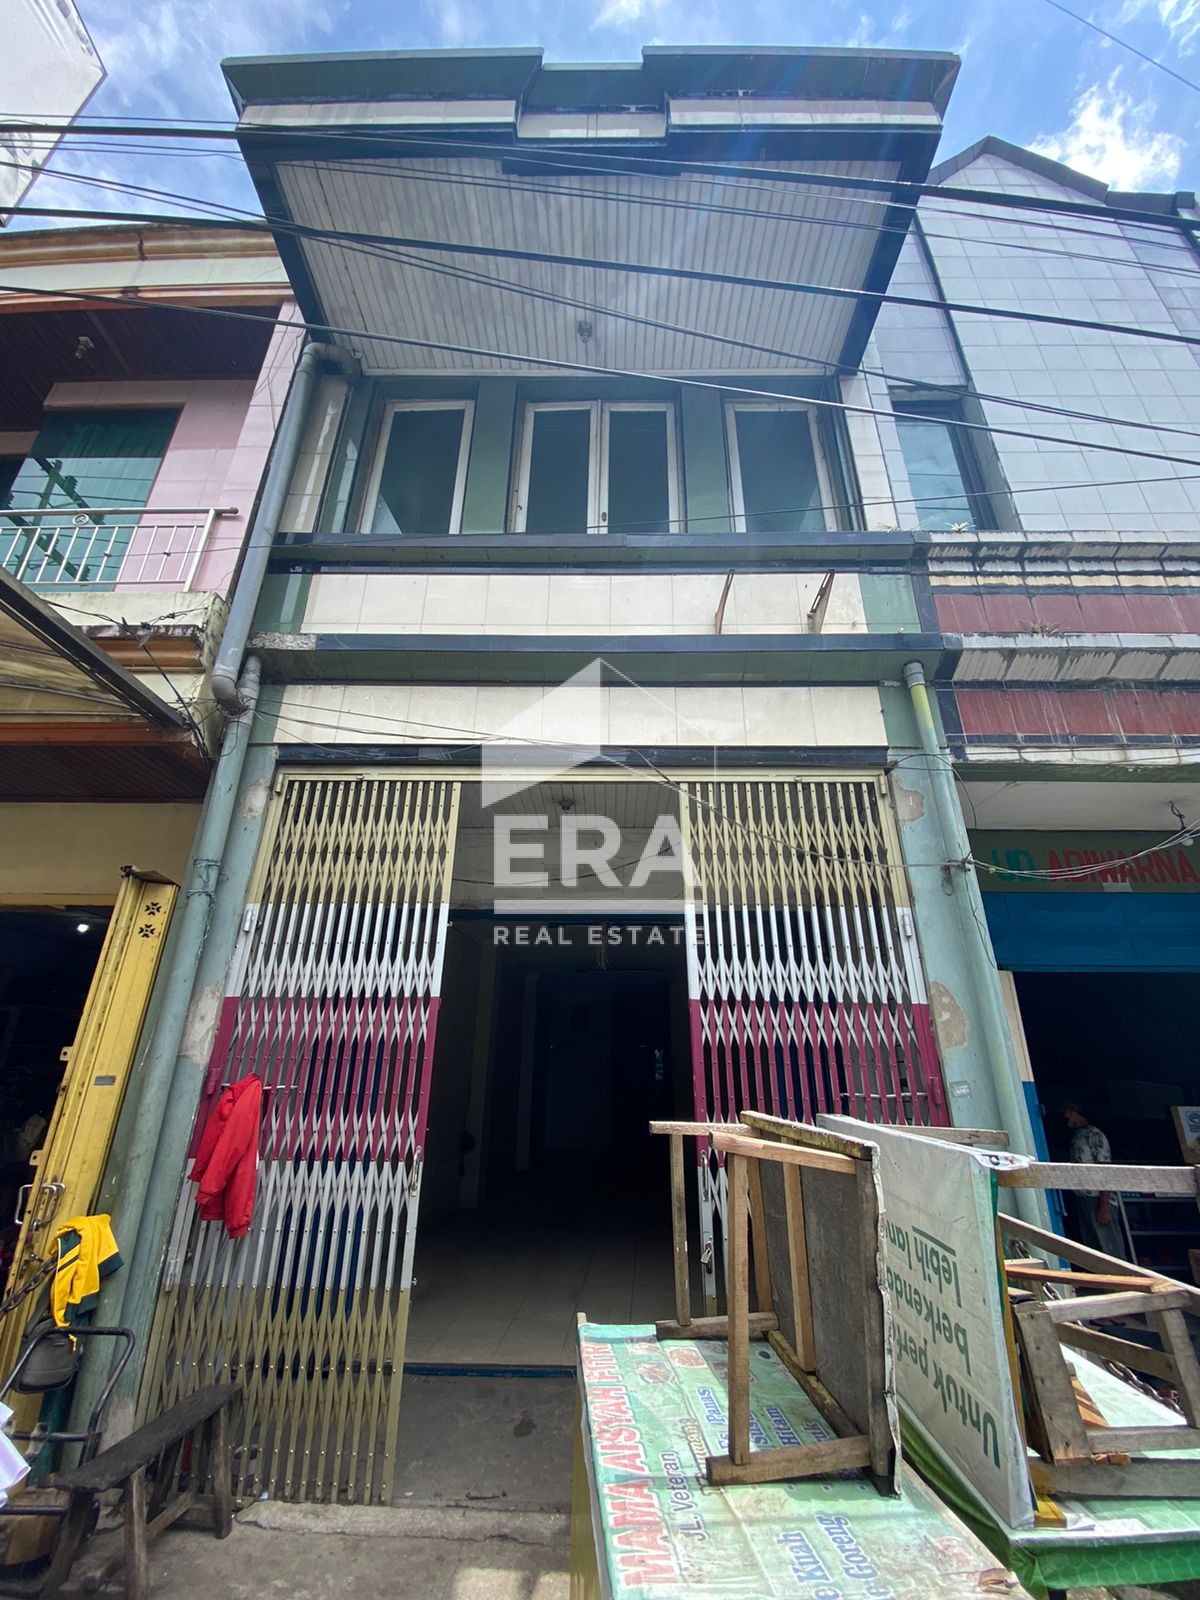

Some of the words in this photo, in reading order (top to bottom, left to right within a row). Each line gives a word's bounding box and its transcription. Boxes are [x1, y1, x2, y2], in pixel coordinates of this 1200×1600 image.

[990, 849, 1037, 882] UD
[1047, 849, 1200, 884] ADIWARNA
[886, 1221, 913, 1270] lan
[914, 1236, 962, 1308] lebih
[589, 1386, 646, 1473] AISYAH
[765, 1404, 801, 1446] Hitam
[933, 1360, 1000, 1469] Untuk
[660, 1452, 693, 1511] Veteran
[606, 1480, 679, 1586] MAMA
[777, 1531, 830, 1582] Kuah
[817, 1515, 879, 1579] Goreng
